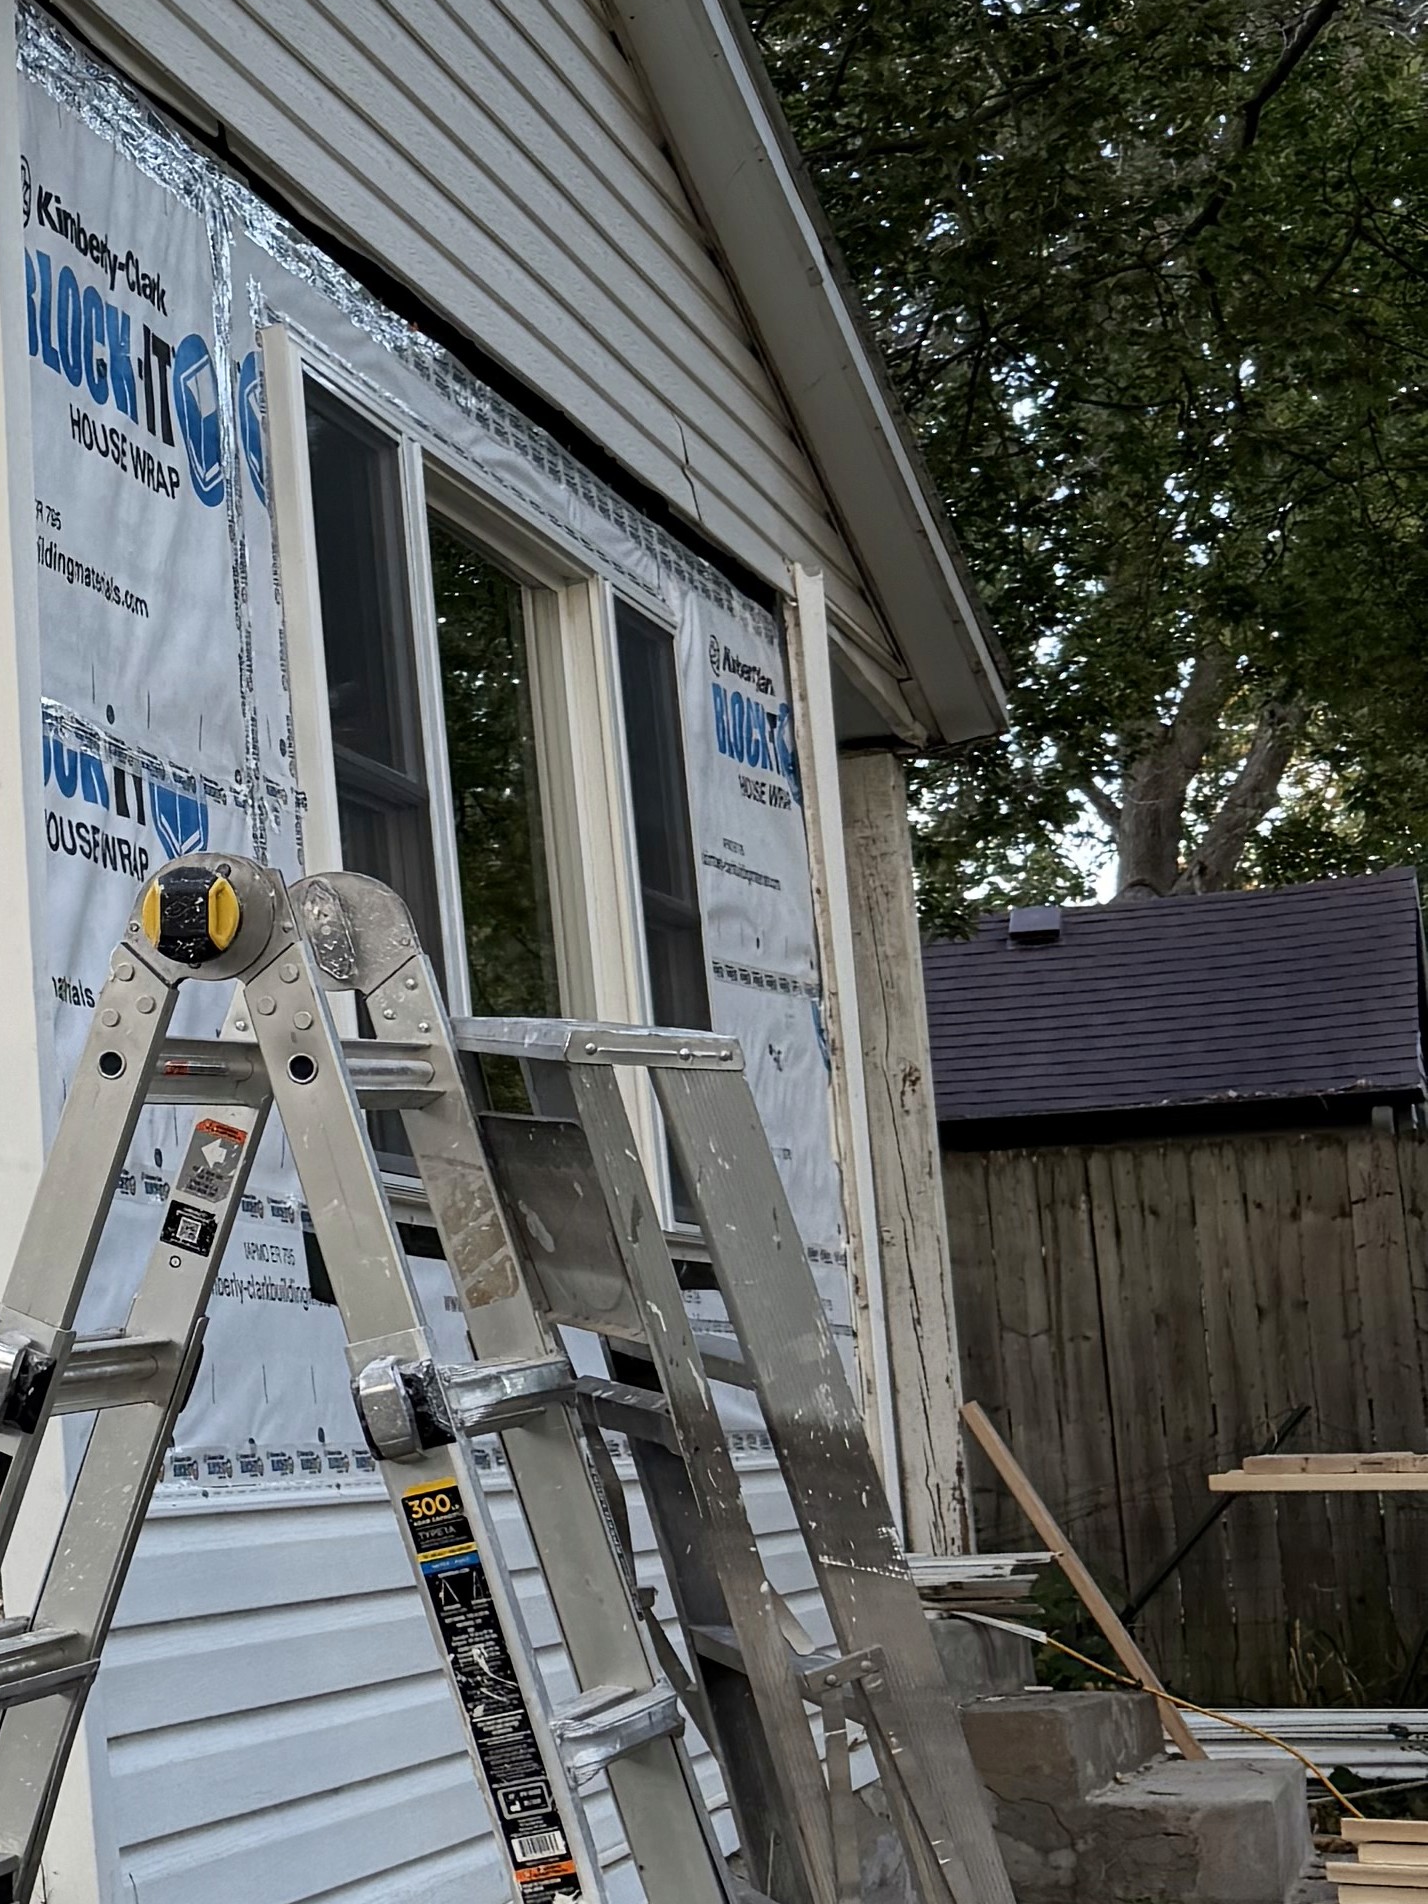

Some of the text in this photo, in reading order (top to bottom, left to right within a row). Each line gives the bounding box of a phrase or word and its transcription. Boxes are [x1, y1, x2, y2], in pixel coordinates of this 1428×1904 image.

[69, 404, 180, 500] HOUSE WRAP
[408, 1494, 451, 1519] 300
